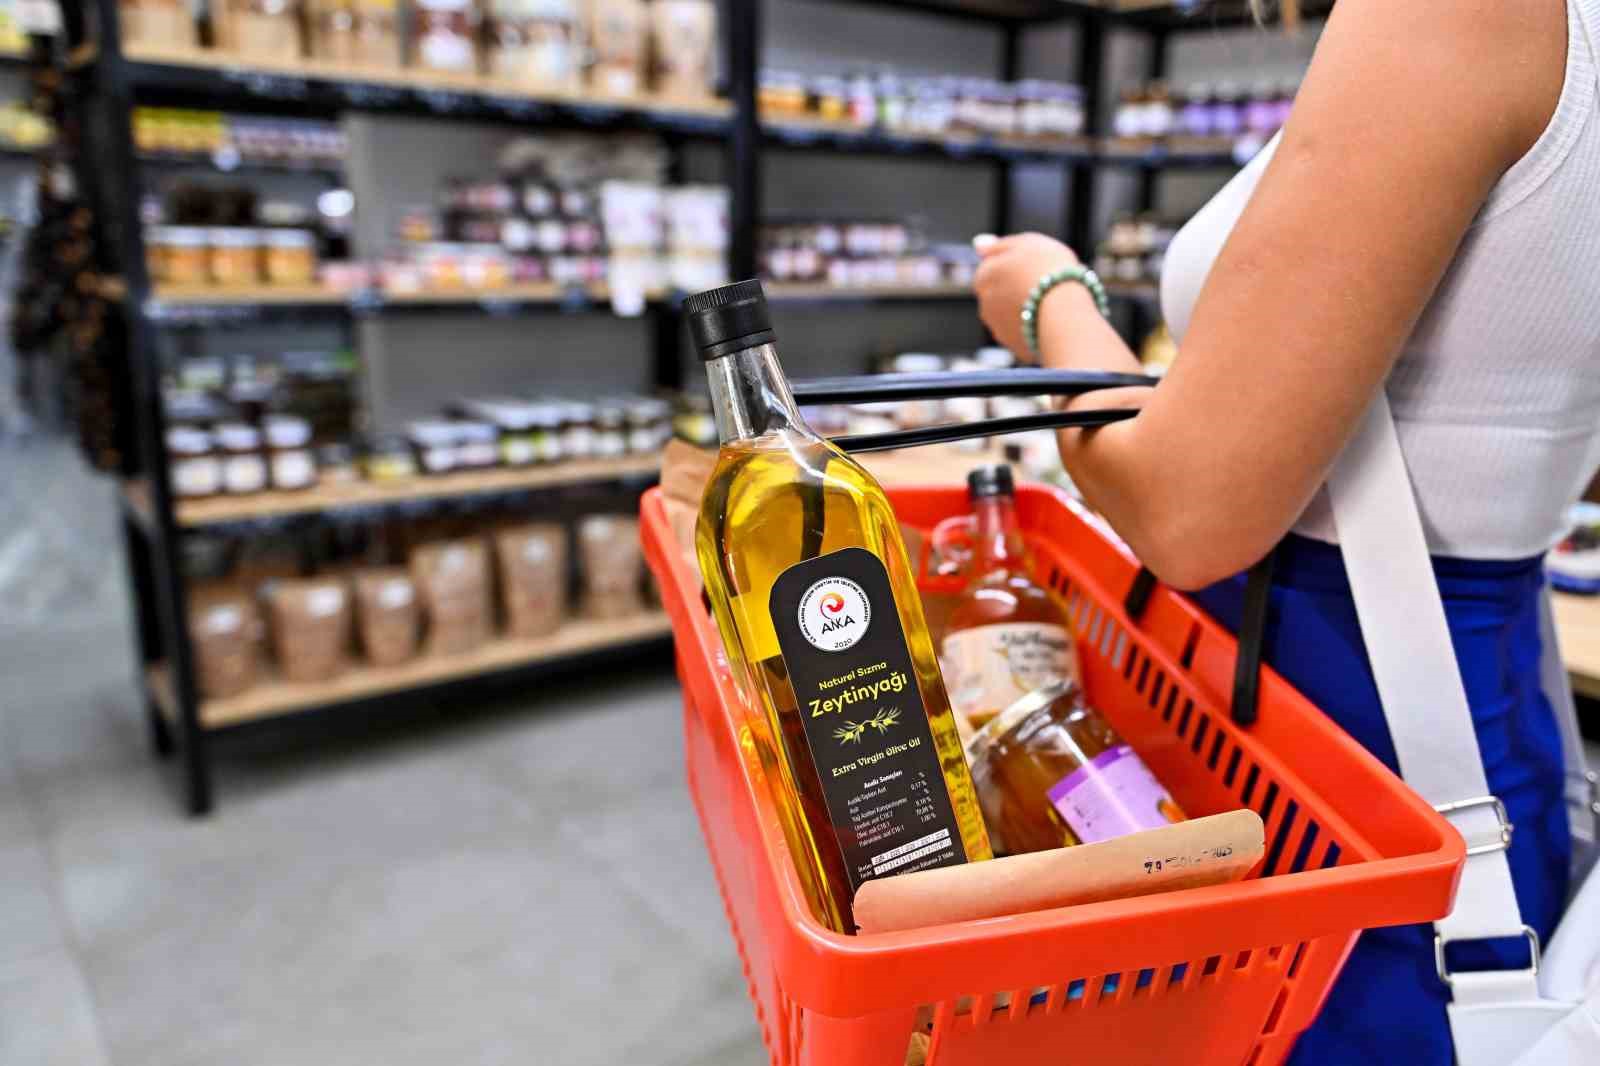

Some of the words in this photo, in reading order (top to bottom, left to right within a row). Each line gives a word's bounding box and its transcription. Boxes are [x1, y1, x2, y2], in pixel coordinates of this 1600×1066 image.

[834, 638, 853, 648] 2020
[819, 669, 856, 691] Naturel
[856, 661, 887, 677] Sızma
[809, 671, 908, 718] Zeytinyağı
[831, 761, 857, 777] Extra
[857, 751, 885, 767] Virgin
[885, 743, 908, 757] Olive
[908, 737, 921, 748] Oil
